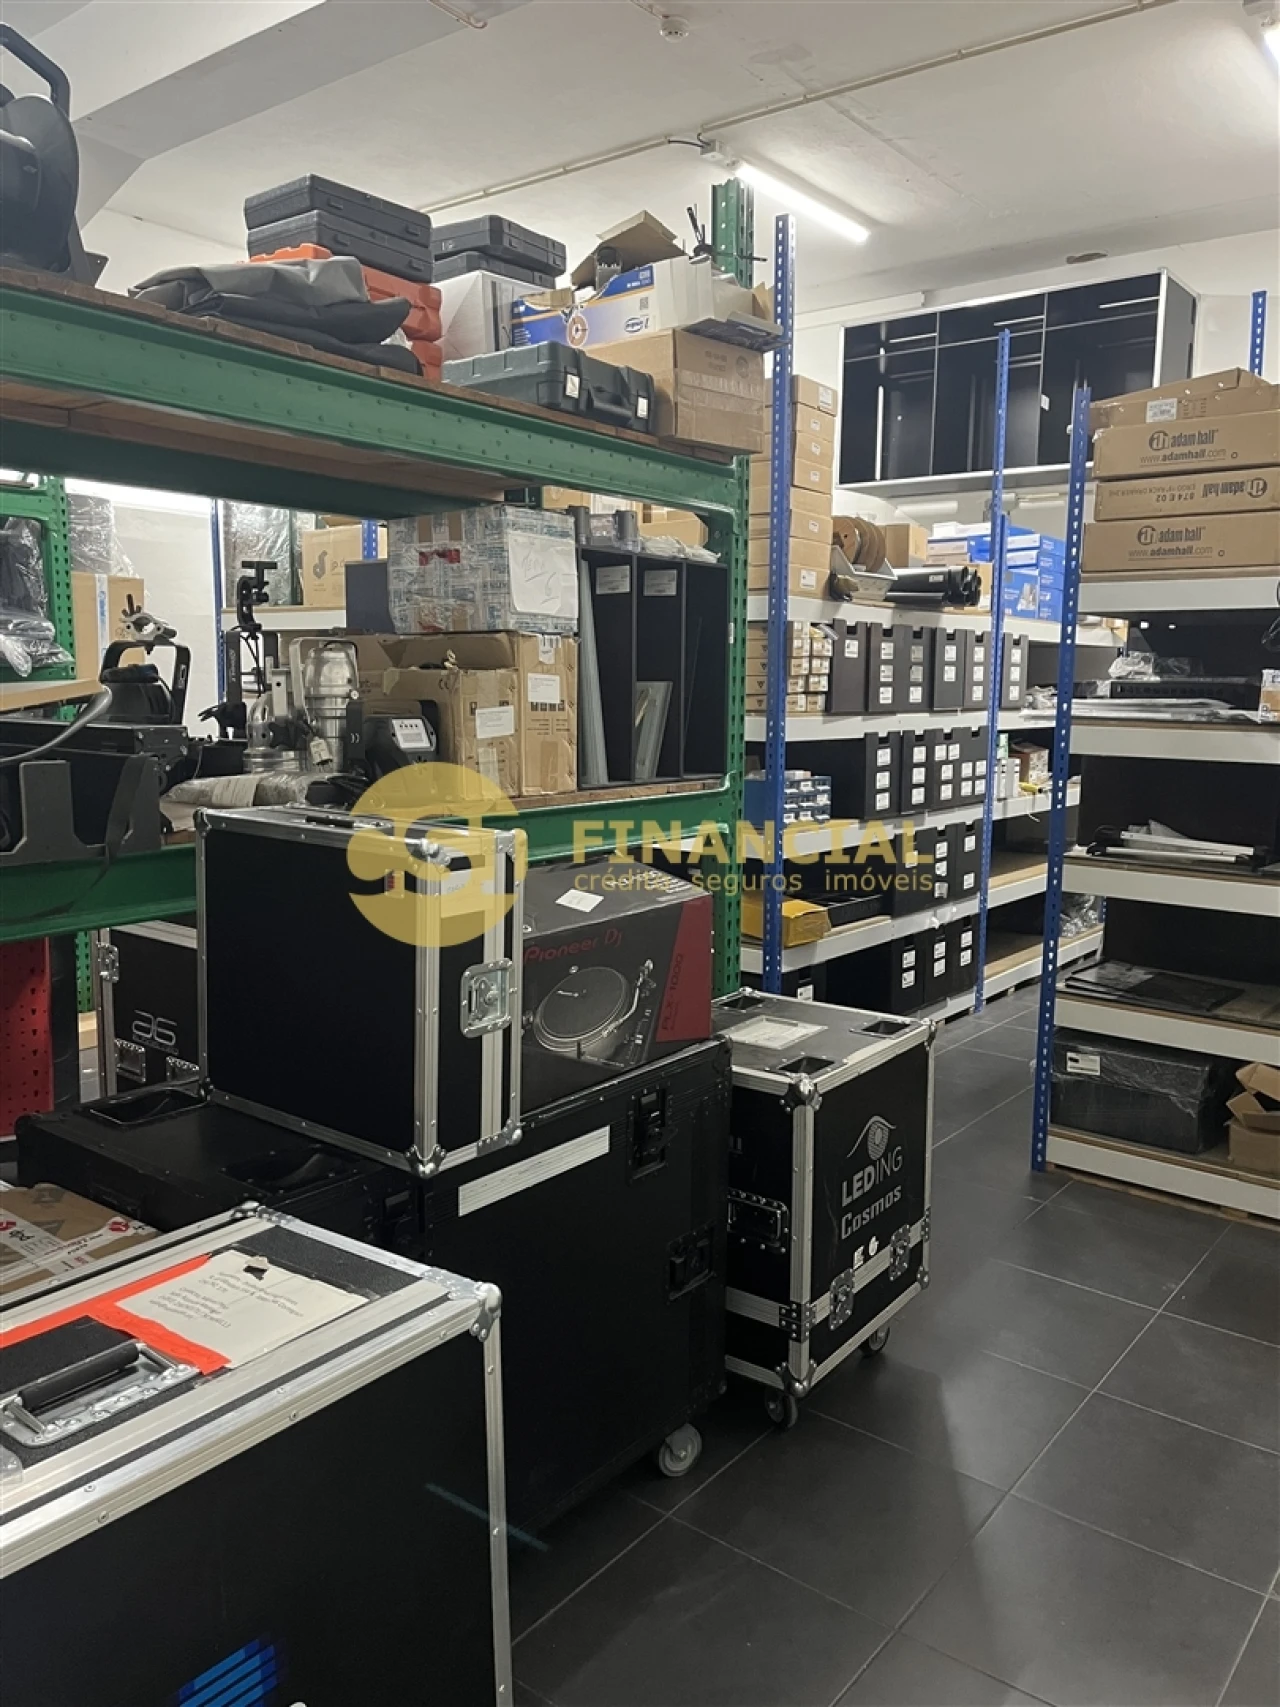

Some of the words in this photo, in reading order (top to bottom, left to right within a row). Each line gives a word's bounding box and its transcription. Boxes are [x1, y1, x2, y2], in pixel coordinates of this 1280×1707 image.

[1170, 432, 1196, 447] adam
[1197, 429, 1215, 445] hall
[1140, 448, 1226, 464] www.adamhall.com
[1202, 483, 1220, 498] hall
[1220, 480, 1245, 495] adam
[1158, 528, 1184, 543] adam
[1185, 526, 1202, 542] hall
[1128, 545, 1213, 558] www.adamhall.com
[523, 937, 599, 965] Pioneer
[662, 953, 684, 1030] PLX-1000
[841, 1146, 903, 1208] LEDING
[841, 1185, 902, 1240] Cosmos
